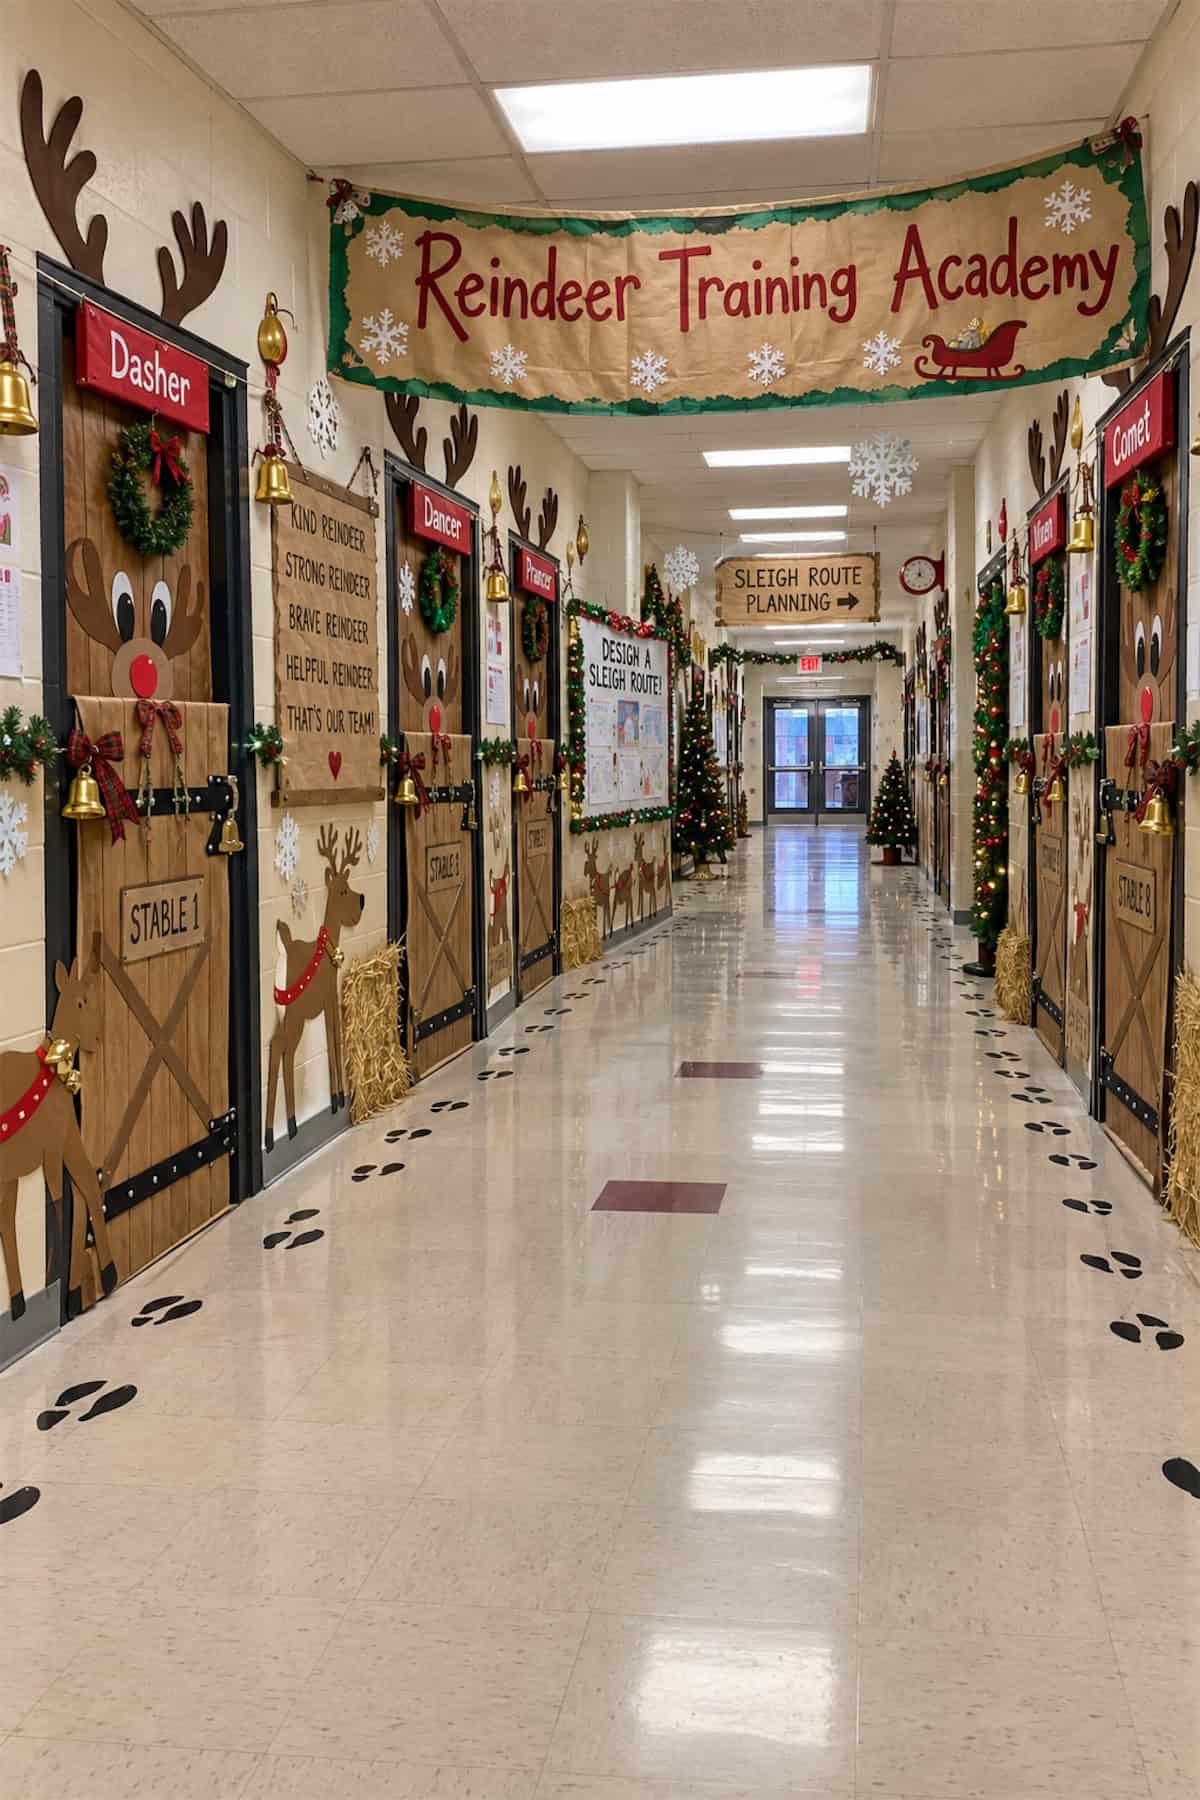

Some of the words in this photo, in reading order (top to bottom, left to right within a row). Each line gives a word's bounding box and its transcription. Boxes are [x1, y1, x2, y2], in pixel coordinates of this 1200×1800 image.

[414, 230, 641, 342] Reindeer
[658, 245, 857, 333] Training
[890, 216, 1120, 317] Academy
[110, 329, 191, 406] Dasher
[1112, 399, 1151, 466] Comet
[290, 503, 317, 535] KIND
[321, 514, 366, 553] REINDEER
[424, 495, 463, 540] Dancer
[285, 551, 325, 587] STRONG
[328, 565, 371, 600] REINDEER
[734, 568, 799, 589] SLEIGH
[808, 566, 863, 587] ROUTE
[746, 593, 831, 614] PLANNING
[289, 603, 321, 634] BRAVE
[326, 611, 369, 645] REINDEER
[286, 653, 329, 685] HELPFUL
[332, 661, 374, 691] REINDEER
[602, 637, 640, 667] DESIGN
[644, 648, 652, 670] A
[800, 656, 820, 672] EXIT
[589, 663, 626, 691] SLEIGH
[631, 671, 663, 696] ROUTE!
[287, 704, 322, 732] THAT'S
[326, 709, 346, 733] OUR
[348, 711, 376, 735] TEAM!
[130, 896, 188, 945] STABLE
[193, 892, 200, 930] 1
[1145, 883, 1151, 918] 8
